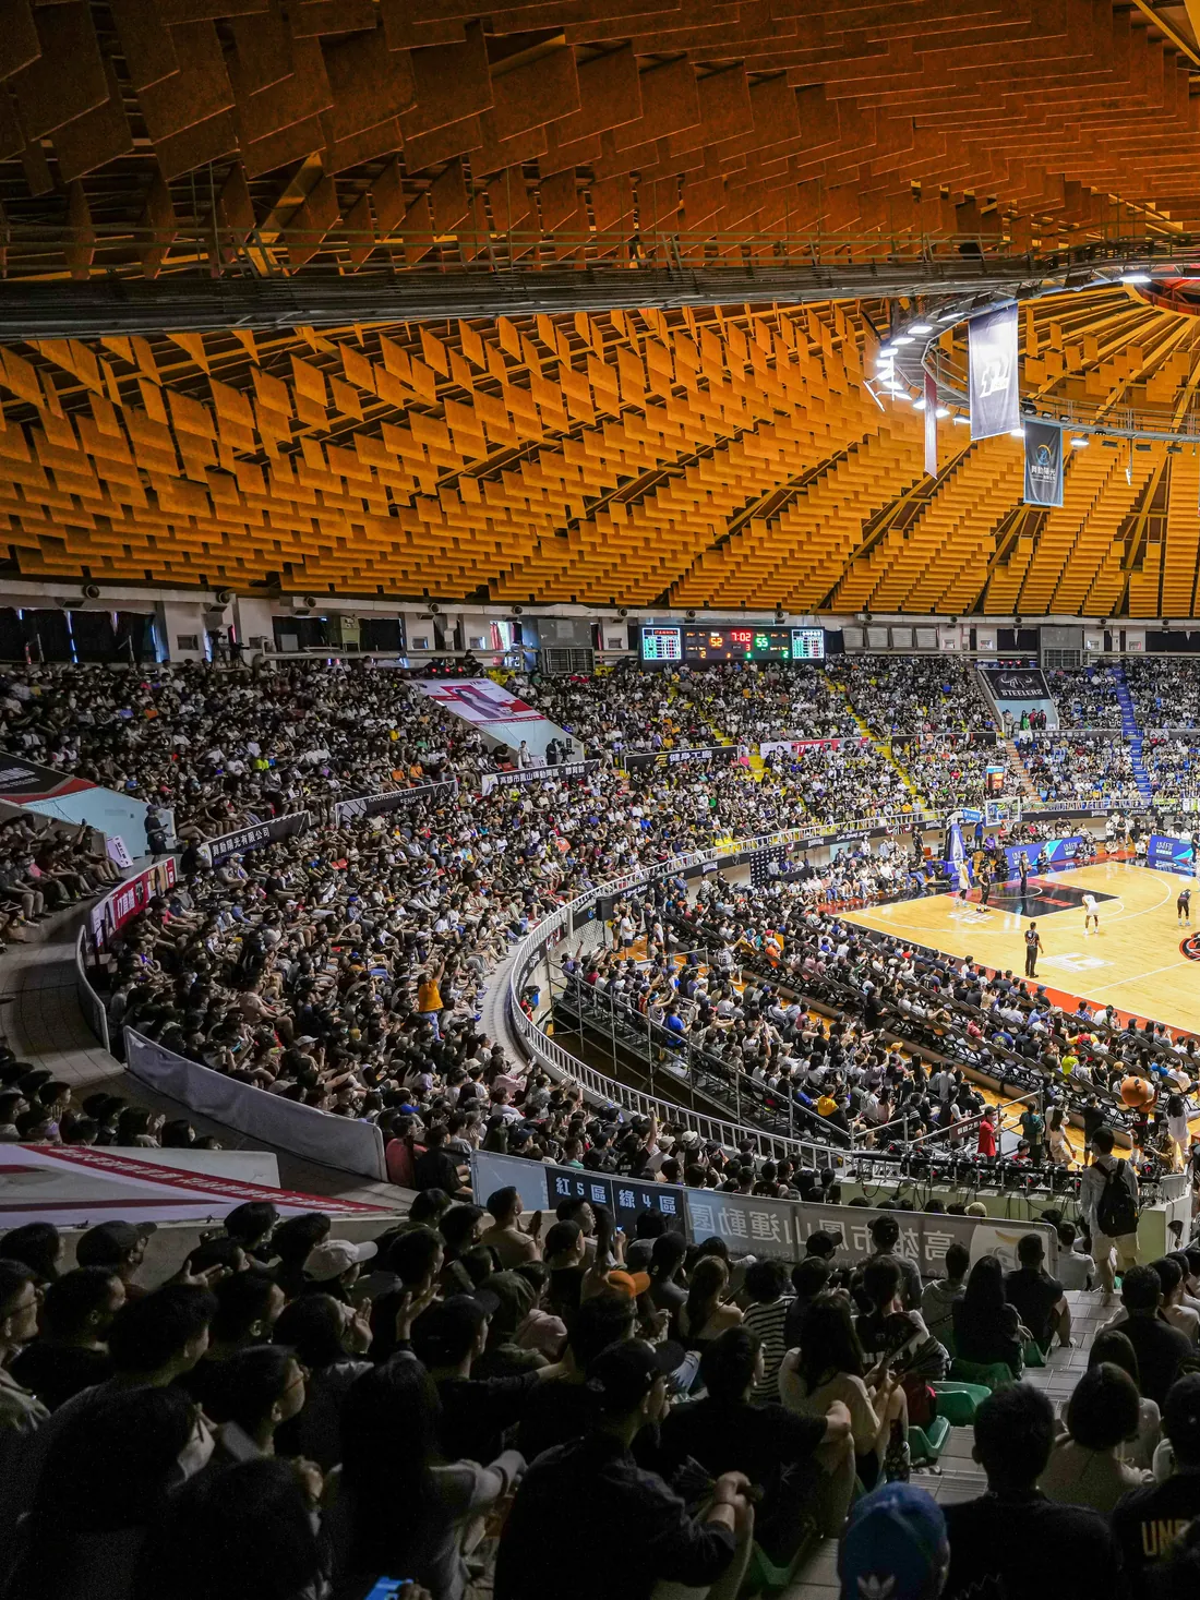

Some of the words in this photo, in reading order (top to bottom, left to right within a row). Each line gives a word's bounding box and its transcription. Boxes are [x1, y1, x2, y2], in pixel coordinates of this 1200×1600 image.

[710, 637, 723, 647] 52
[731, 632, 752, 642] 7:02
[755, 637, 769, 648] 55
